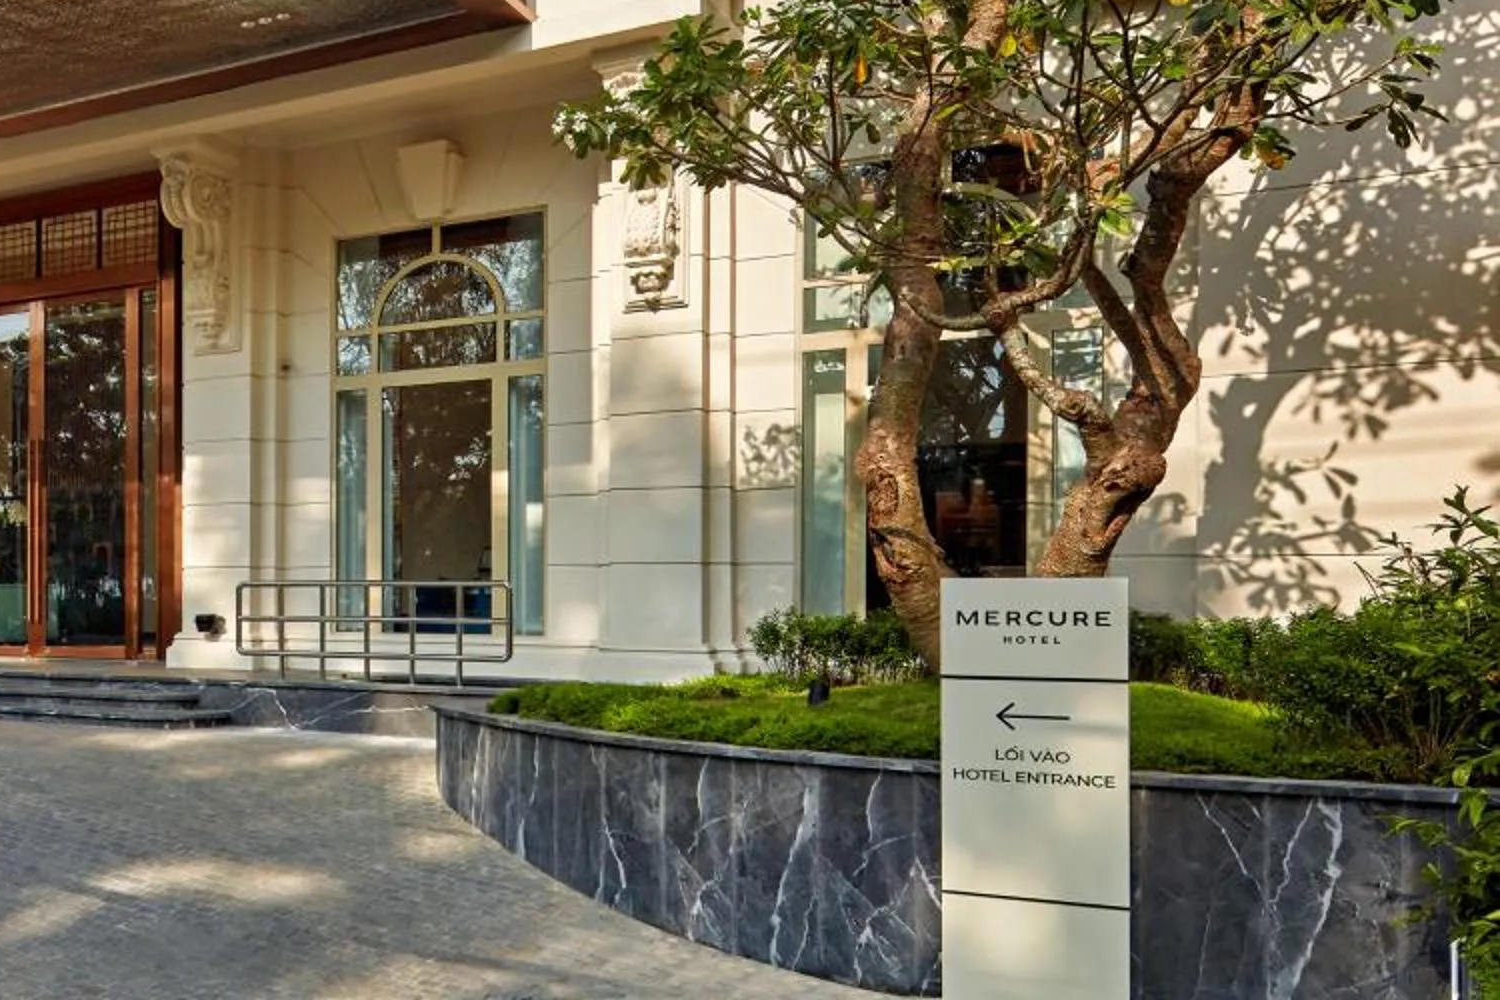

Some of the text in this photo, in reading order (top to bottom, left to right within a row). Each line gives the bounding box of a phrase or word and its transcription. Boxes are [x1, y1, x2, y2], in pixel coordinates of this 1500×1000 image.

[956, 610, 1112, 627] MERCURE
[1002, 635, 1062, 645] HOTEL
[953, 767, 1116, 789] HOTEL ENTRANCE
